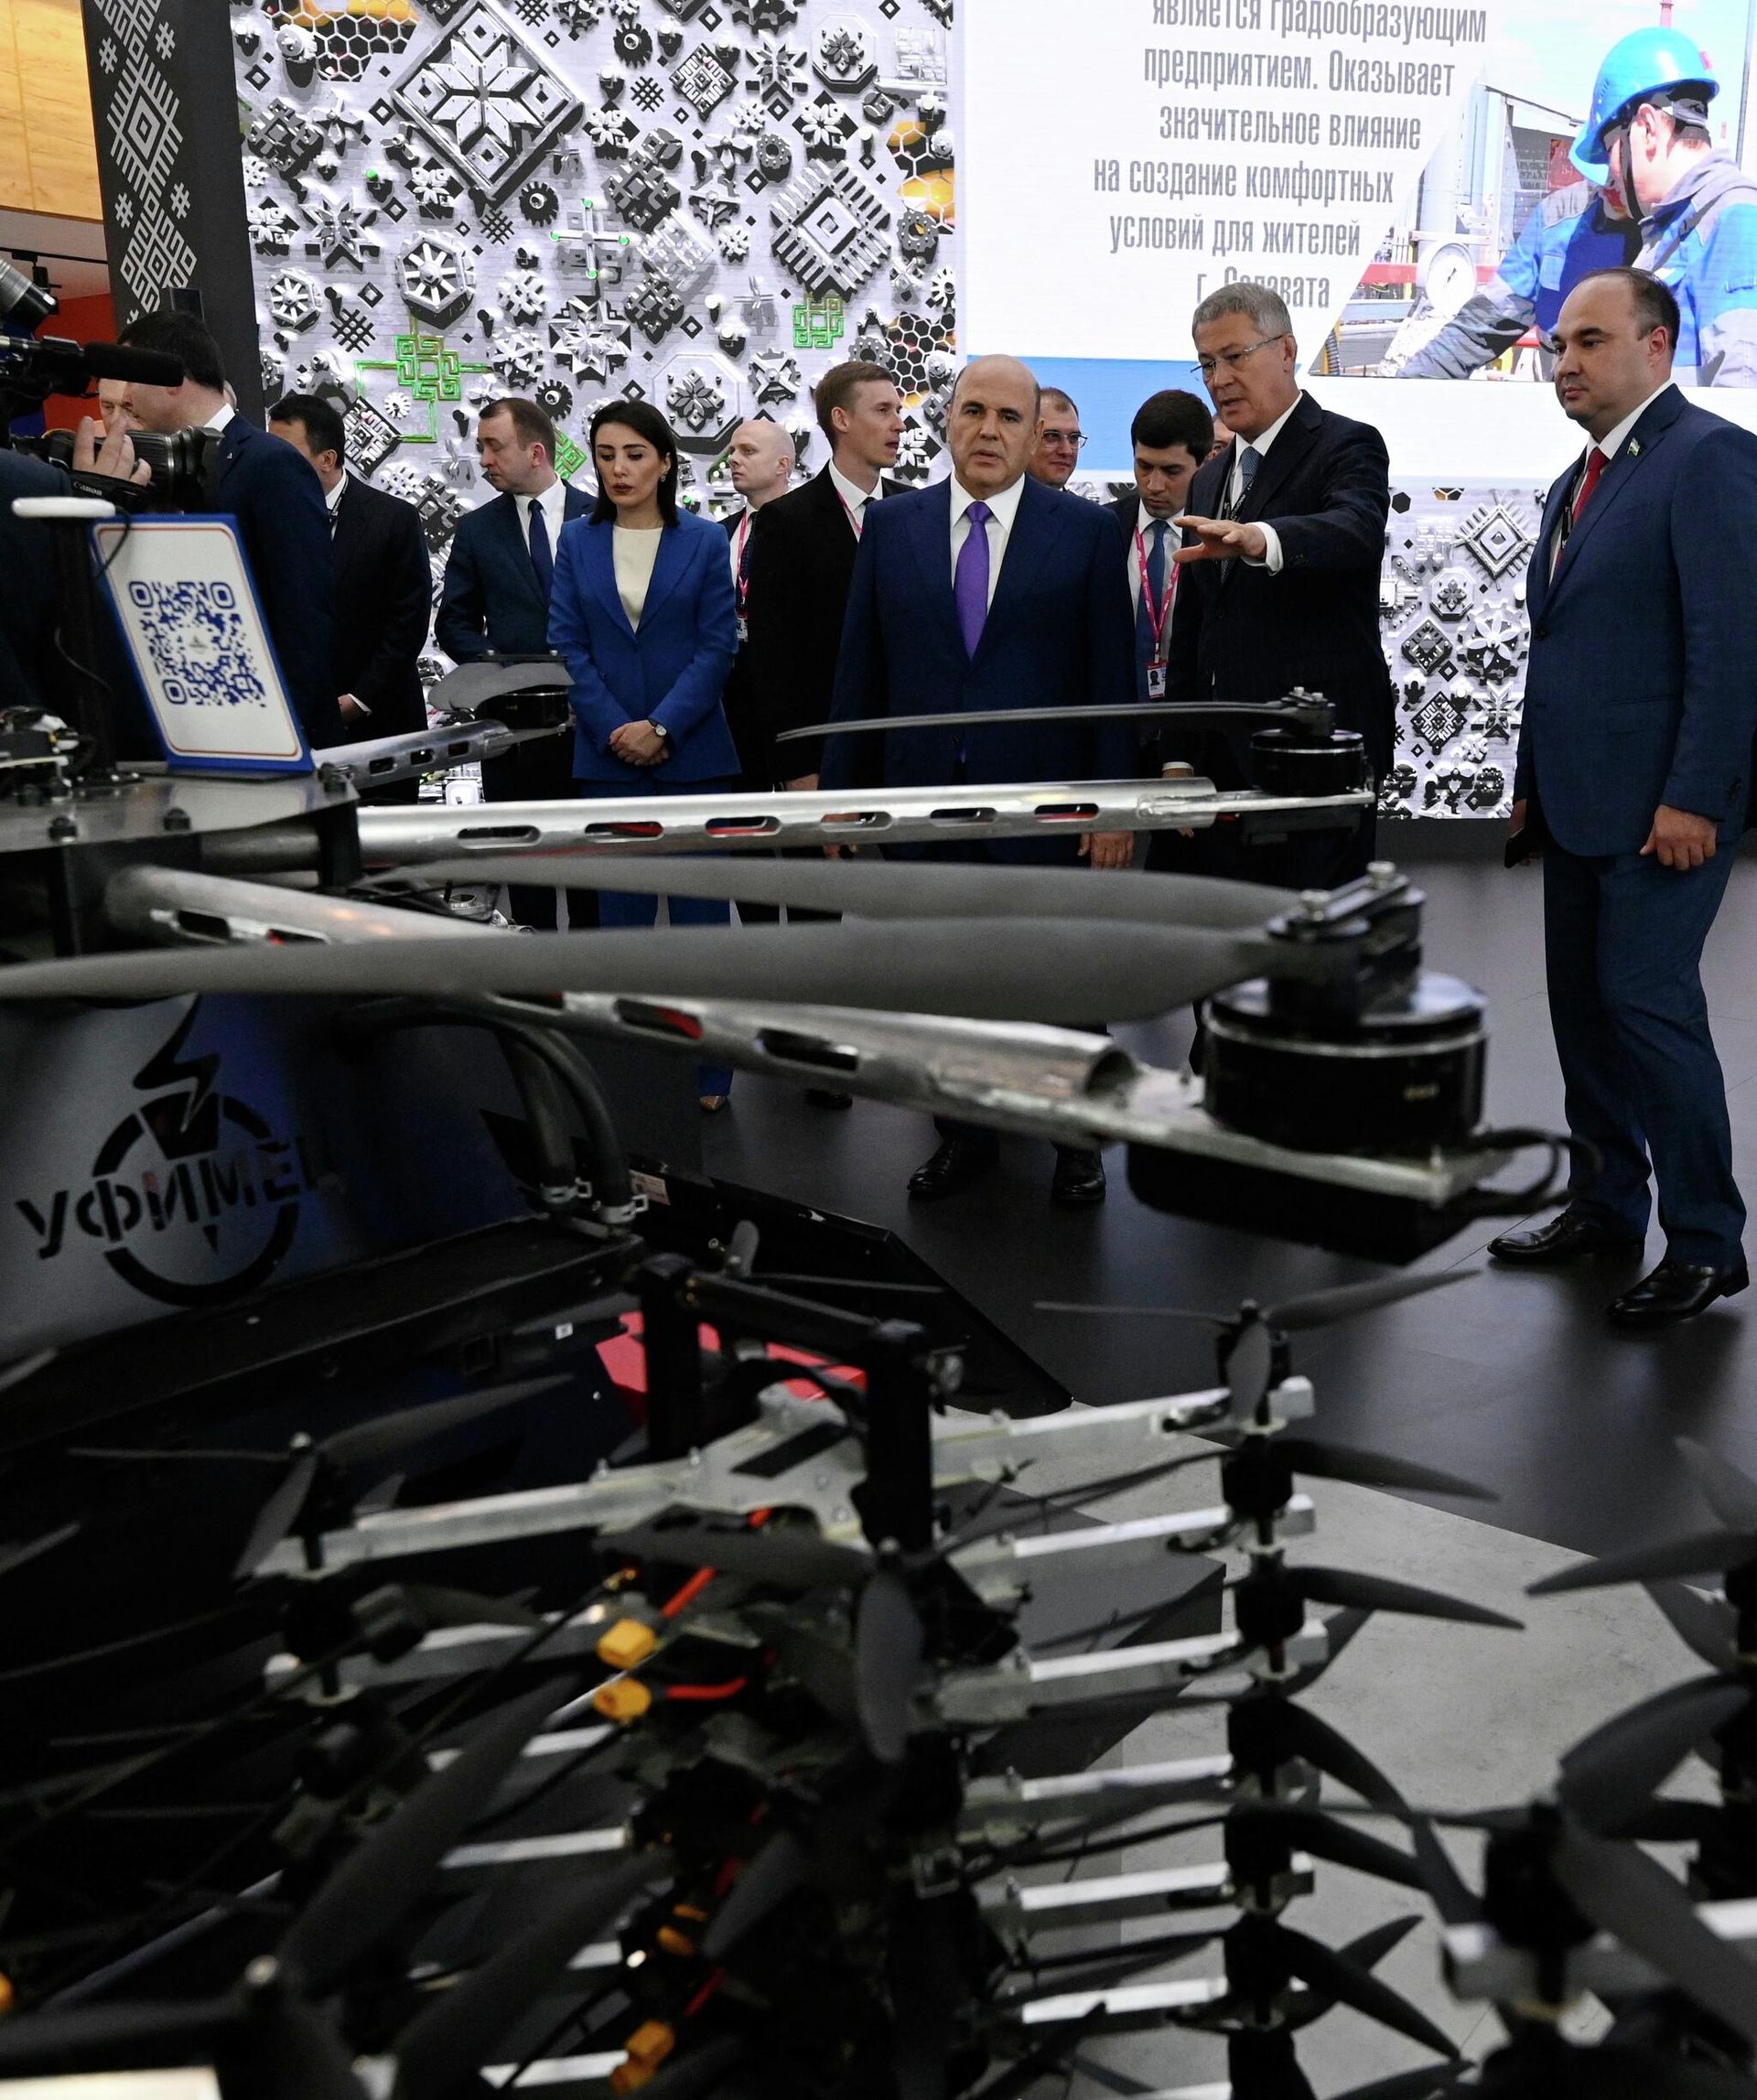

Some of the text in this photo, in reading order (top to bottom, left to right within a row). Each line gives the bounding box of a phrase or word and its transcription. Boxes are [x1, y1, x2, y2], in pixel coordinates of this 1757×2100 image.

[1153, 0, 1486, 47] является градообразующим
[1144, 48, 1455, 96] предприятием. Оказывает
[1159, 106, 1421, 150] значительное влияние
[1094, 159, 1393, 207] на создание комфортных
[1109, 214, 1360, 257] условий для жителей
[73, 481, 102, 496] Canon
[16, 1135, 313, 1260] УФИМЕ
